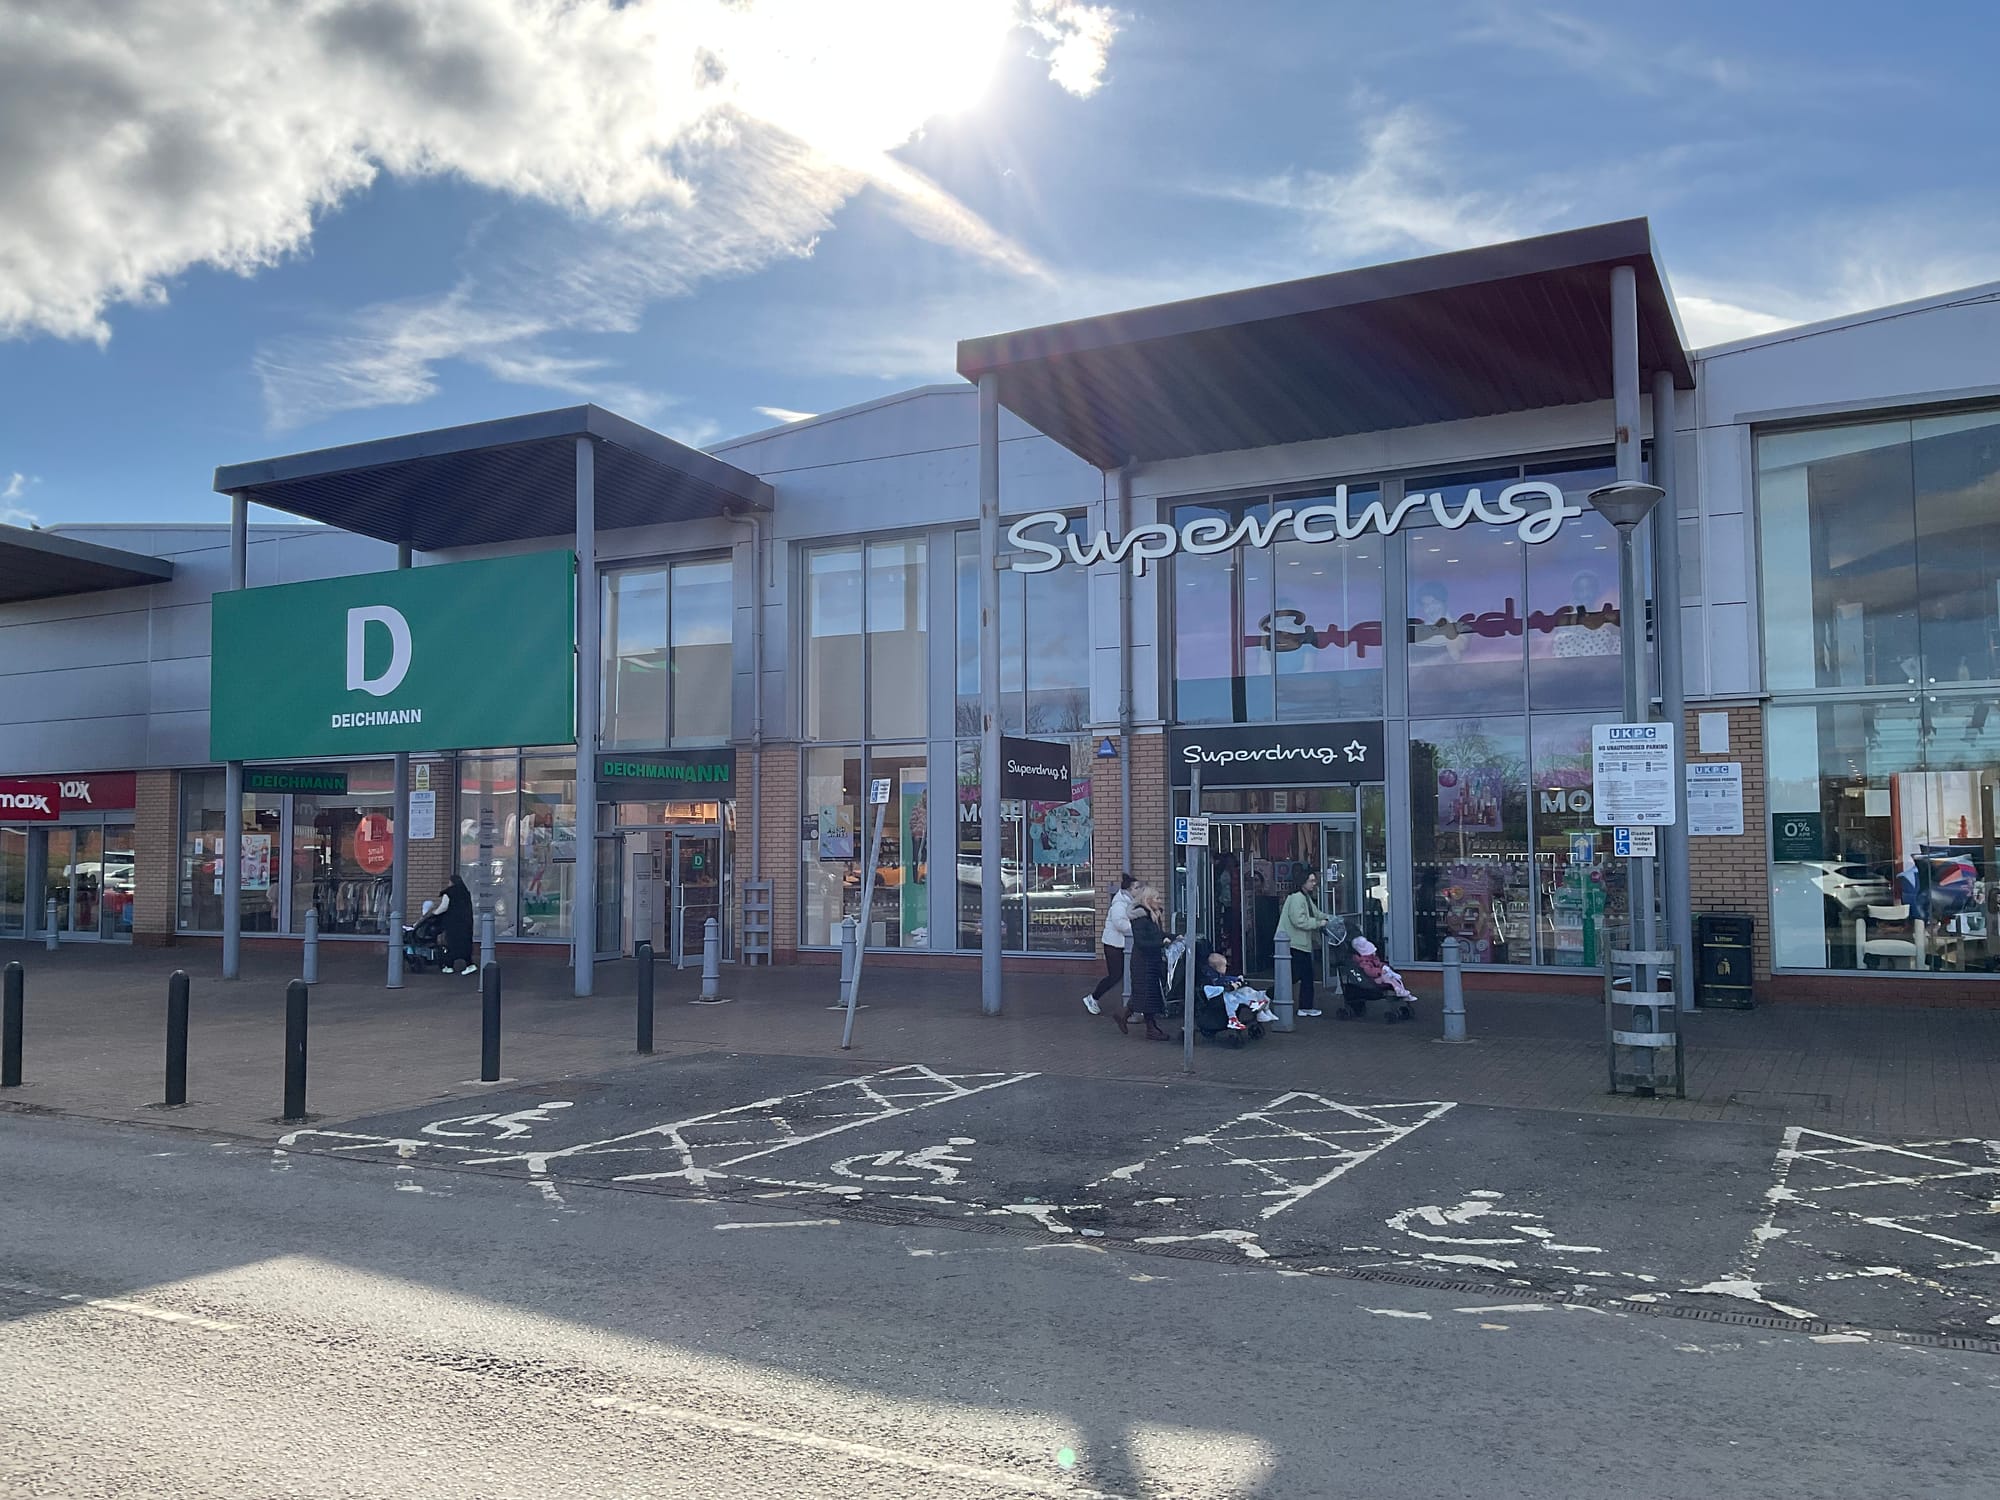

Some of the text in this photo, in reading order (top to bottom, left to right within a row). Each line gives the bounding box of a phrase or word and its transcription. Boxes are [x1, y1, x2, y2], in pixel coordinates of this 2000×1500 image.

[1007, 481, 1583, 577] Superdrug
[347, 605, 413, 697] D
[331, 709, 422, 728] DEICHMANN
[1609, 728, 1656, 739] UKPC
[1183, 744, 1338, 766] Superdrug
[604, 761, 686, 780] DEICHMANN
[1007, 759, 1060, 781] Superdrug
[1695, 766, 1729, 774] UKPC
[252, 774, 345, 790] DEICHMANN
[1540, 789, 1593, 814] MO
[959, 802, 1021, 823] MRE
[1618, 829, 1628, 840] P
[1784, 822, 1810, 837] 0%
[368, 845, 385, 856] small
[368, 855, 385, 865] prices
[1030, 912, 1093, 926] PIERCING
